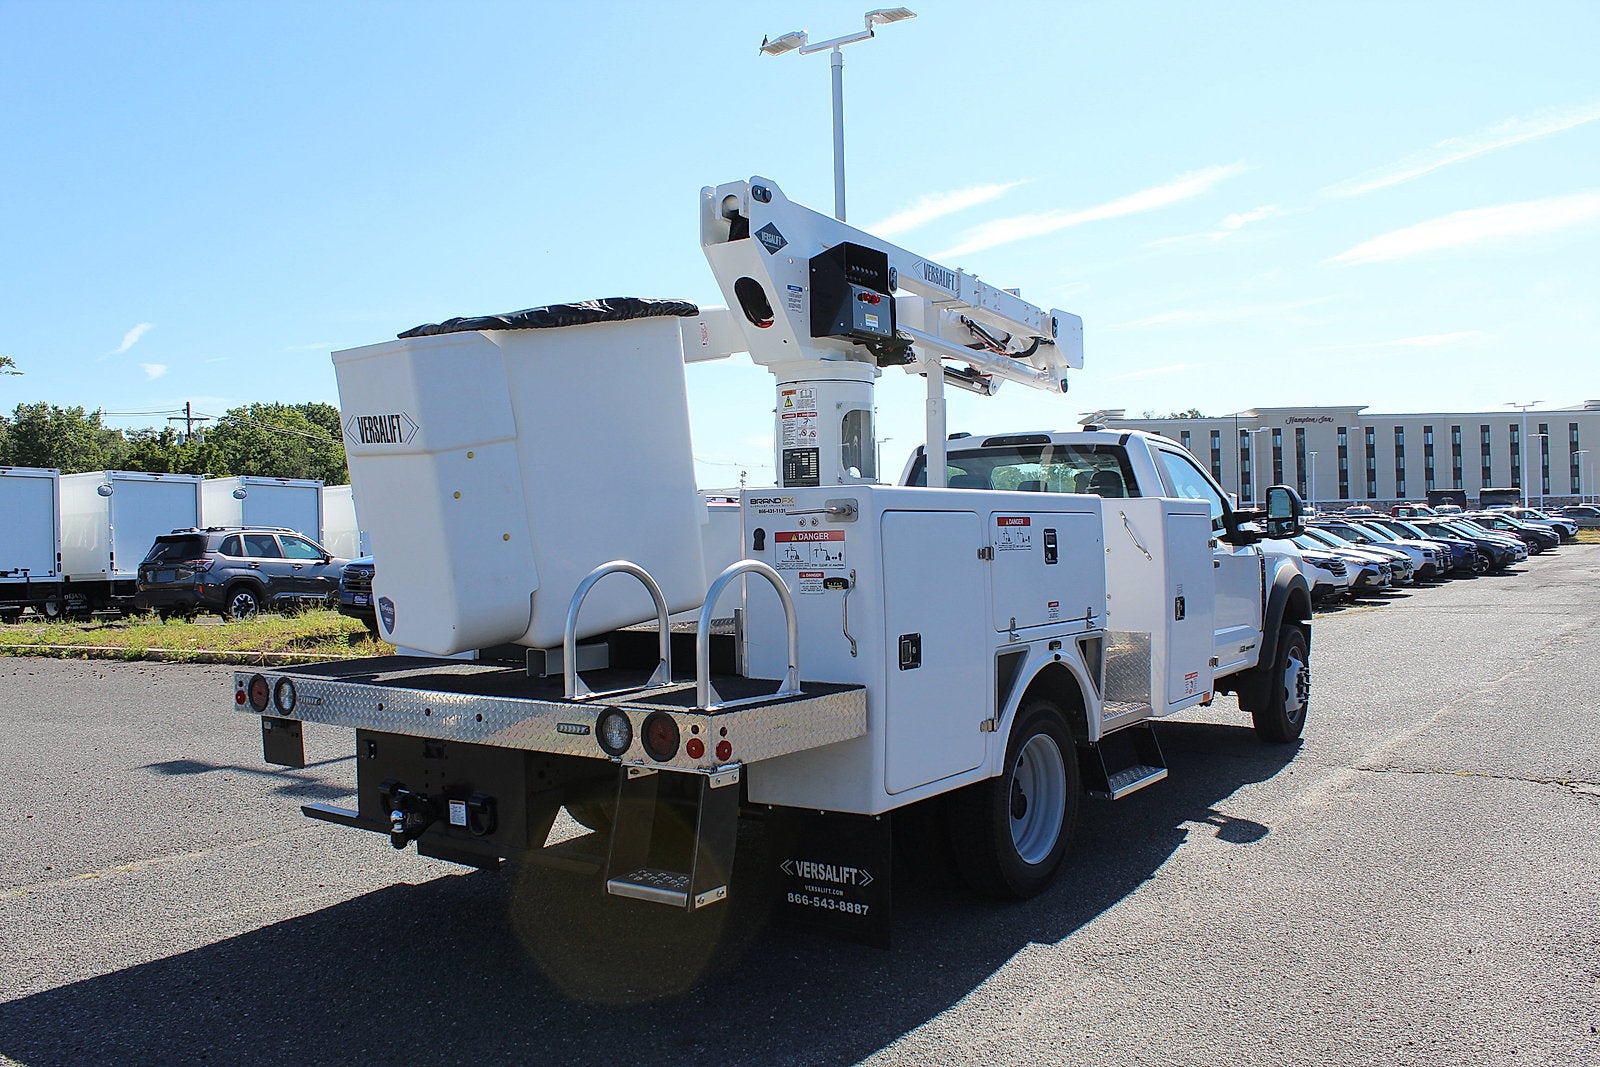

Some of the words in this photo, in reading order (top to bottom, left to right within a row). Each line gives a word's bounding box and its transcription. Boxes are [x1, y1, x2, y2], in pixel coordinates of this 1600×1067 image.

[923, 262, 955, 291] VERSALIFT
[357, 414, 403, 444] VERSALIFT
[1286, 416, 1317, 424] Hampton
[750, 497, 794, 505] BRANDFX
[798, 533, 829, 541] DANGER
[795, 860, 858, 886] VERSALIFT
[804, 884, 844, 896] VERSALIFT.COM
[787, 892, 869, 916] 866-543-8887
